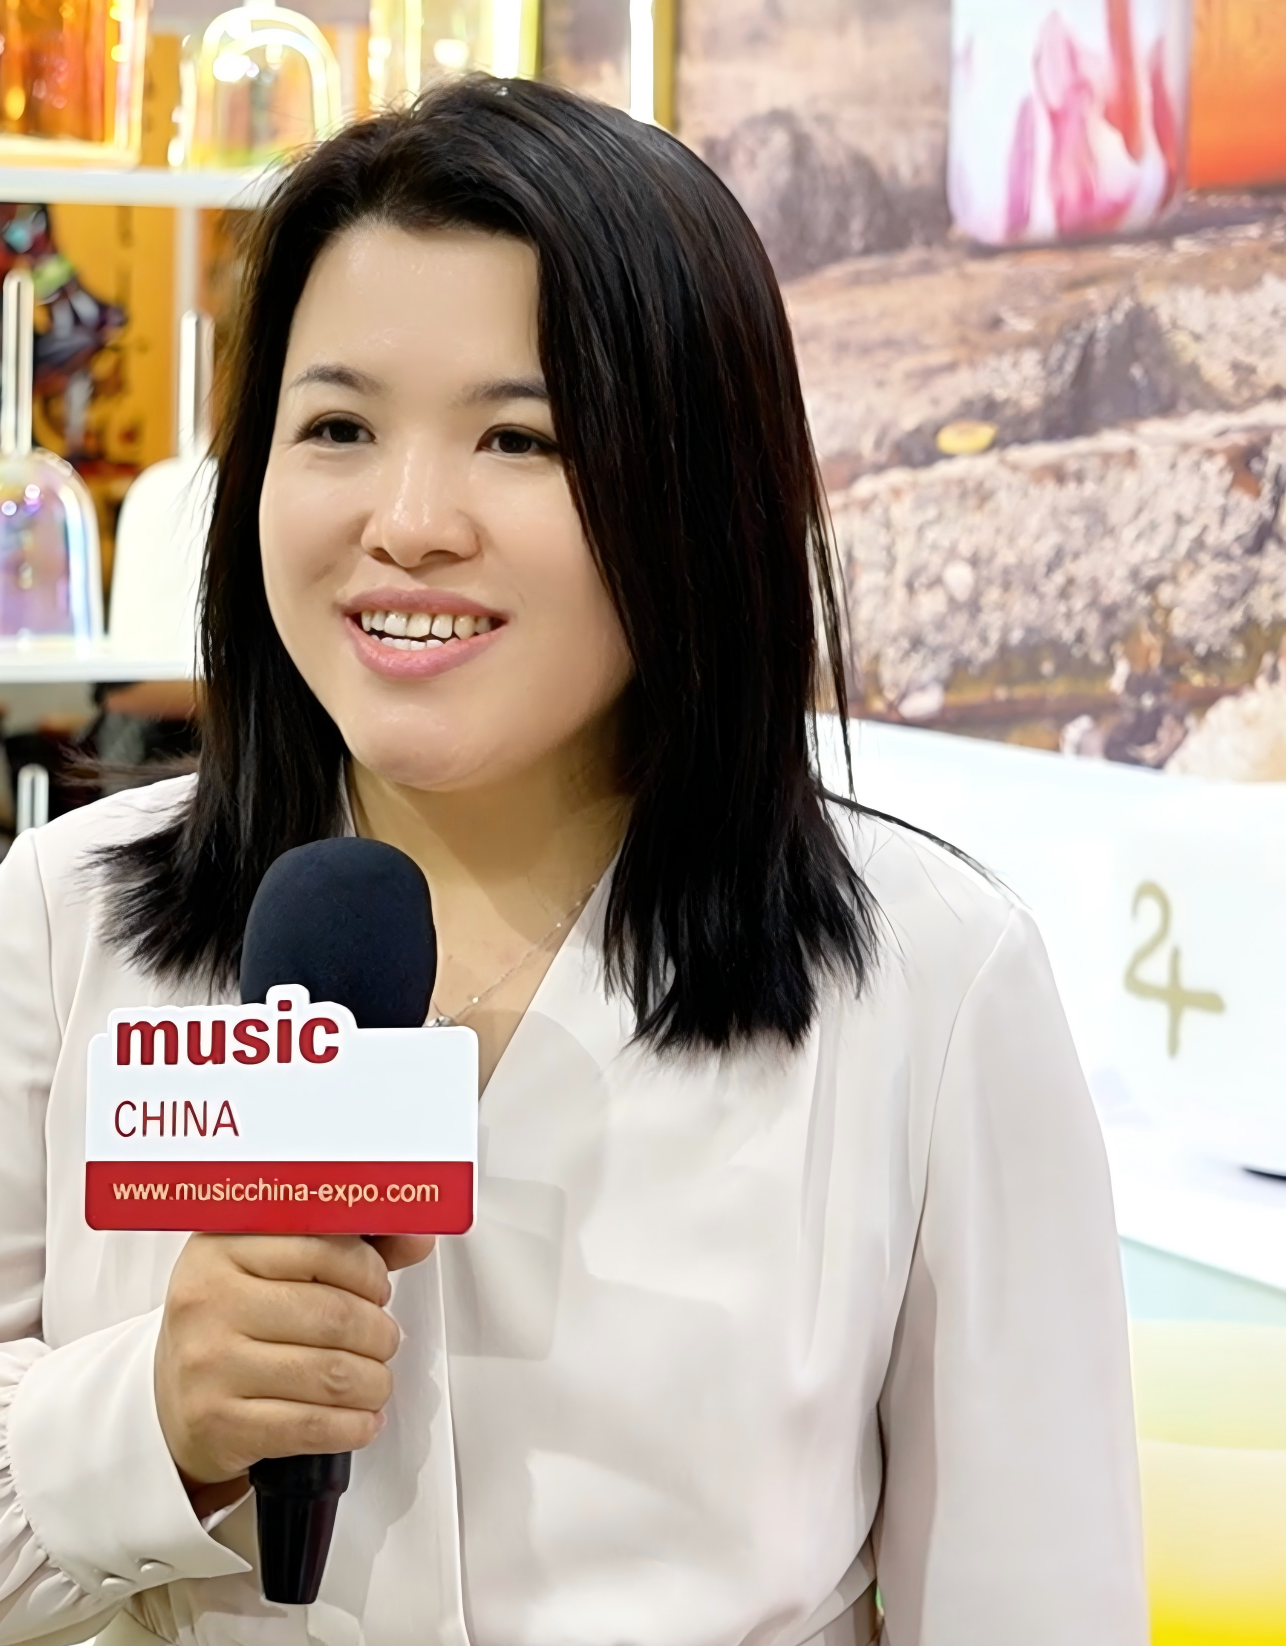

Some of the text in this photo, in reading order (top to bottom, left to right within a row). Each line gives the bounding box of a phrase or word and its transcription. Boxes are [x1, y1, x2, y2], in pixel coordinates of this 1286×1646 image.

[116, 1000, 339, 1066] music
[114, 1100, 239, 1137] CHINA
[112, 1178, 440, 1207] www.musicchina-expo.com
